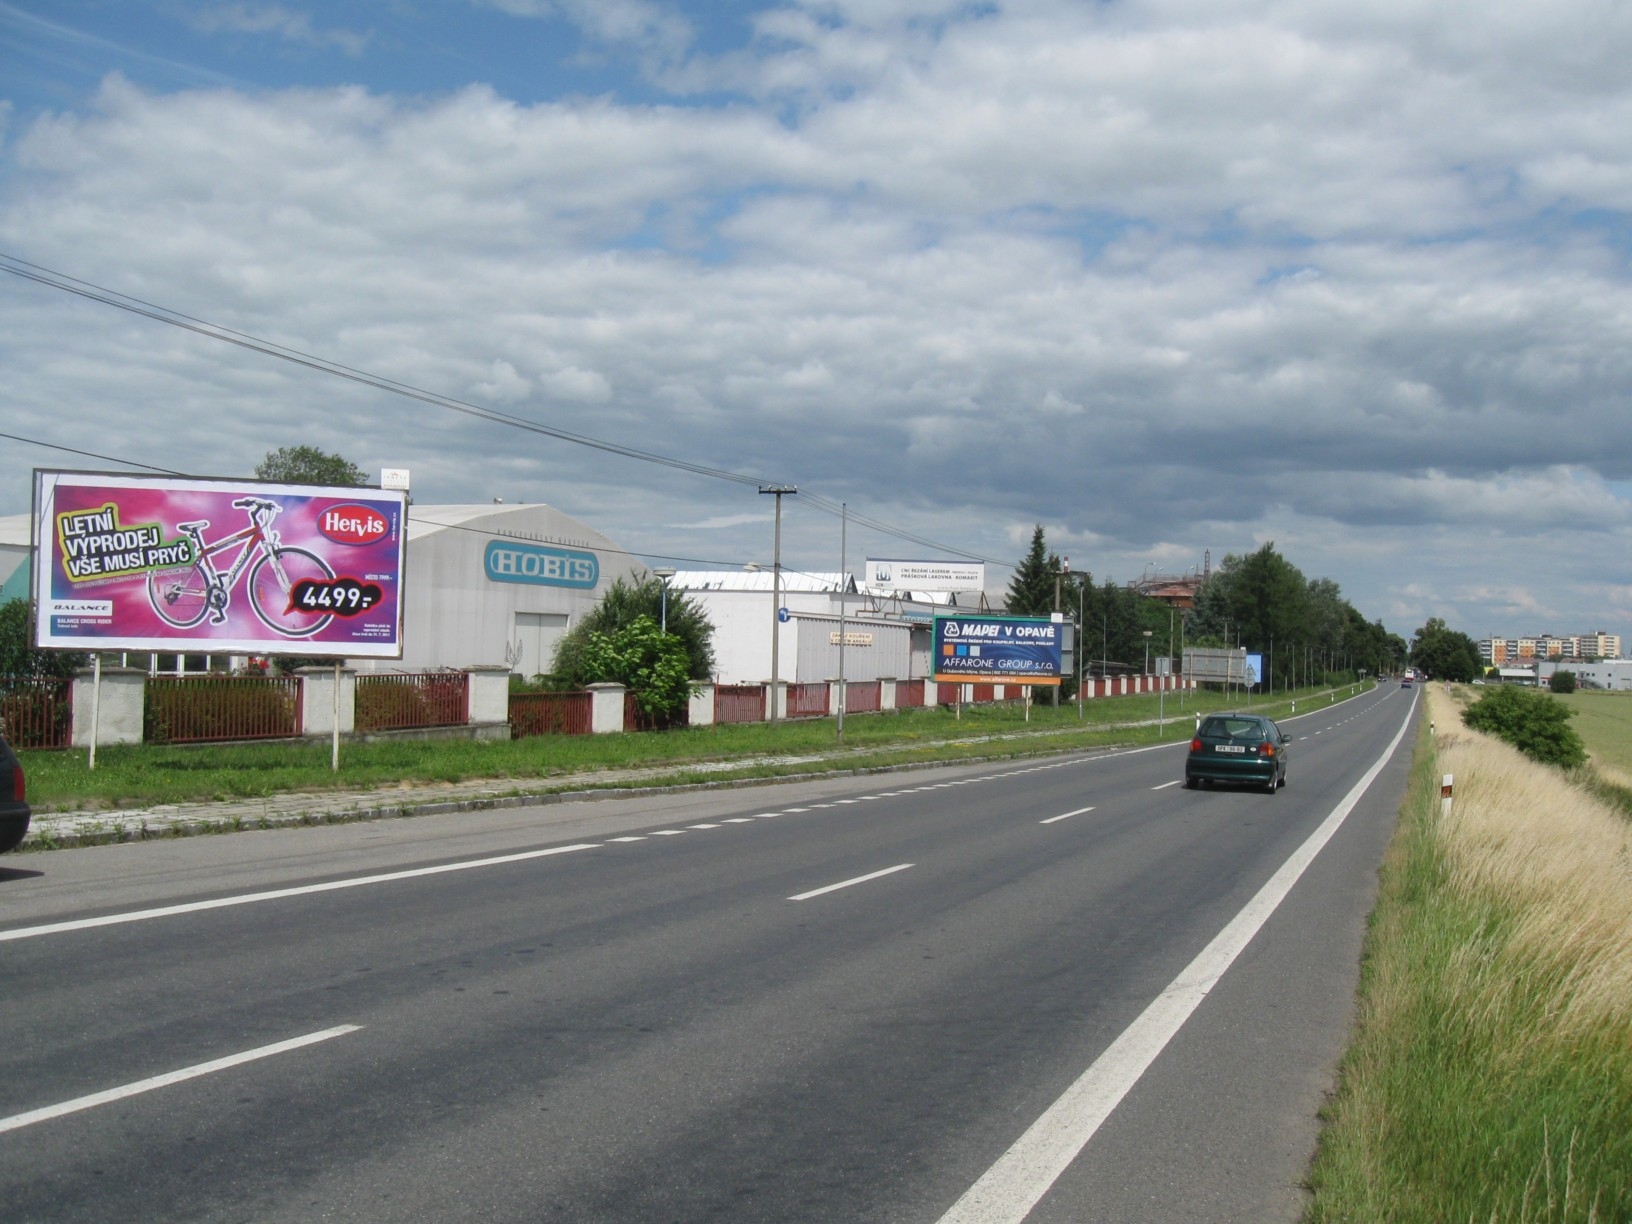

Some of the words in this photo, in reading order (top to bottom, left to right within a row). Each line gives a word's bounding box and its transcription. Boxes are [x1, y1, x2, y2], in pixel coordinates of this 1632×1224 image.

[63, 508, 114, 536] LETNÍ
[325, 512, 384, 536] Hervis
[65, 528, 159, 557] VÝPRODEJ
[68, 556, 102, 576] VŠE
[104, 548, 145, 572] MUSÍ
[148, 542, 190, 566] PRYČ
[491, 549, 595, 582] HOBIS
[961, 624, 1000, 637] MAPEI
[1005, 626, 1013, 636] V
[1016, 625, 1055, 638] OPAVĚ
[943, 657, 994, 668] AFFARONE
[998, 659, 1032, 669] GROUP
[1035, 662, 1054, 670] s.r.o.
